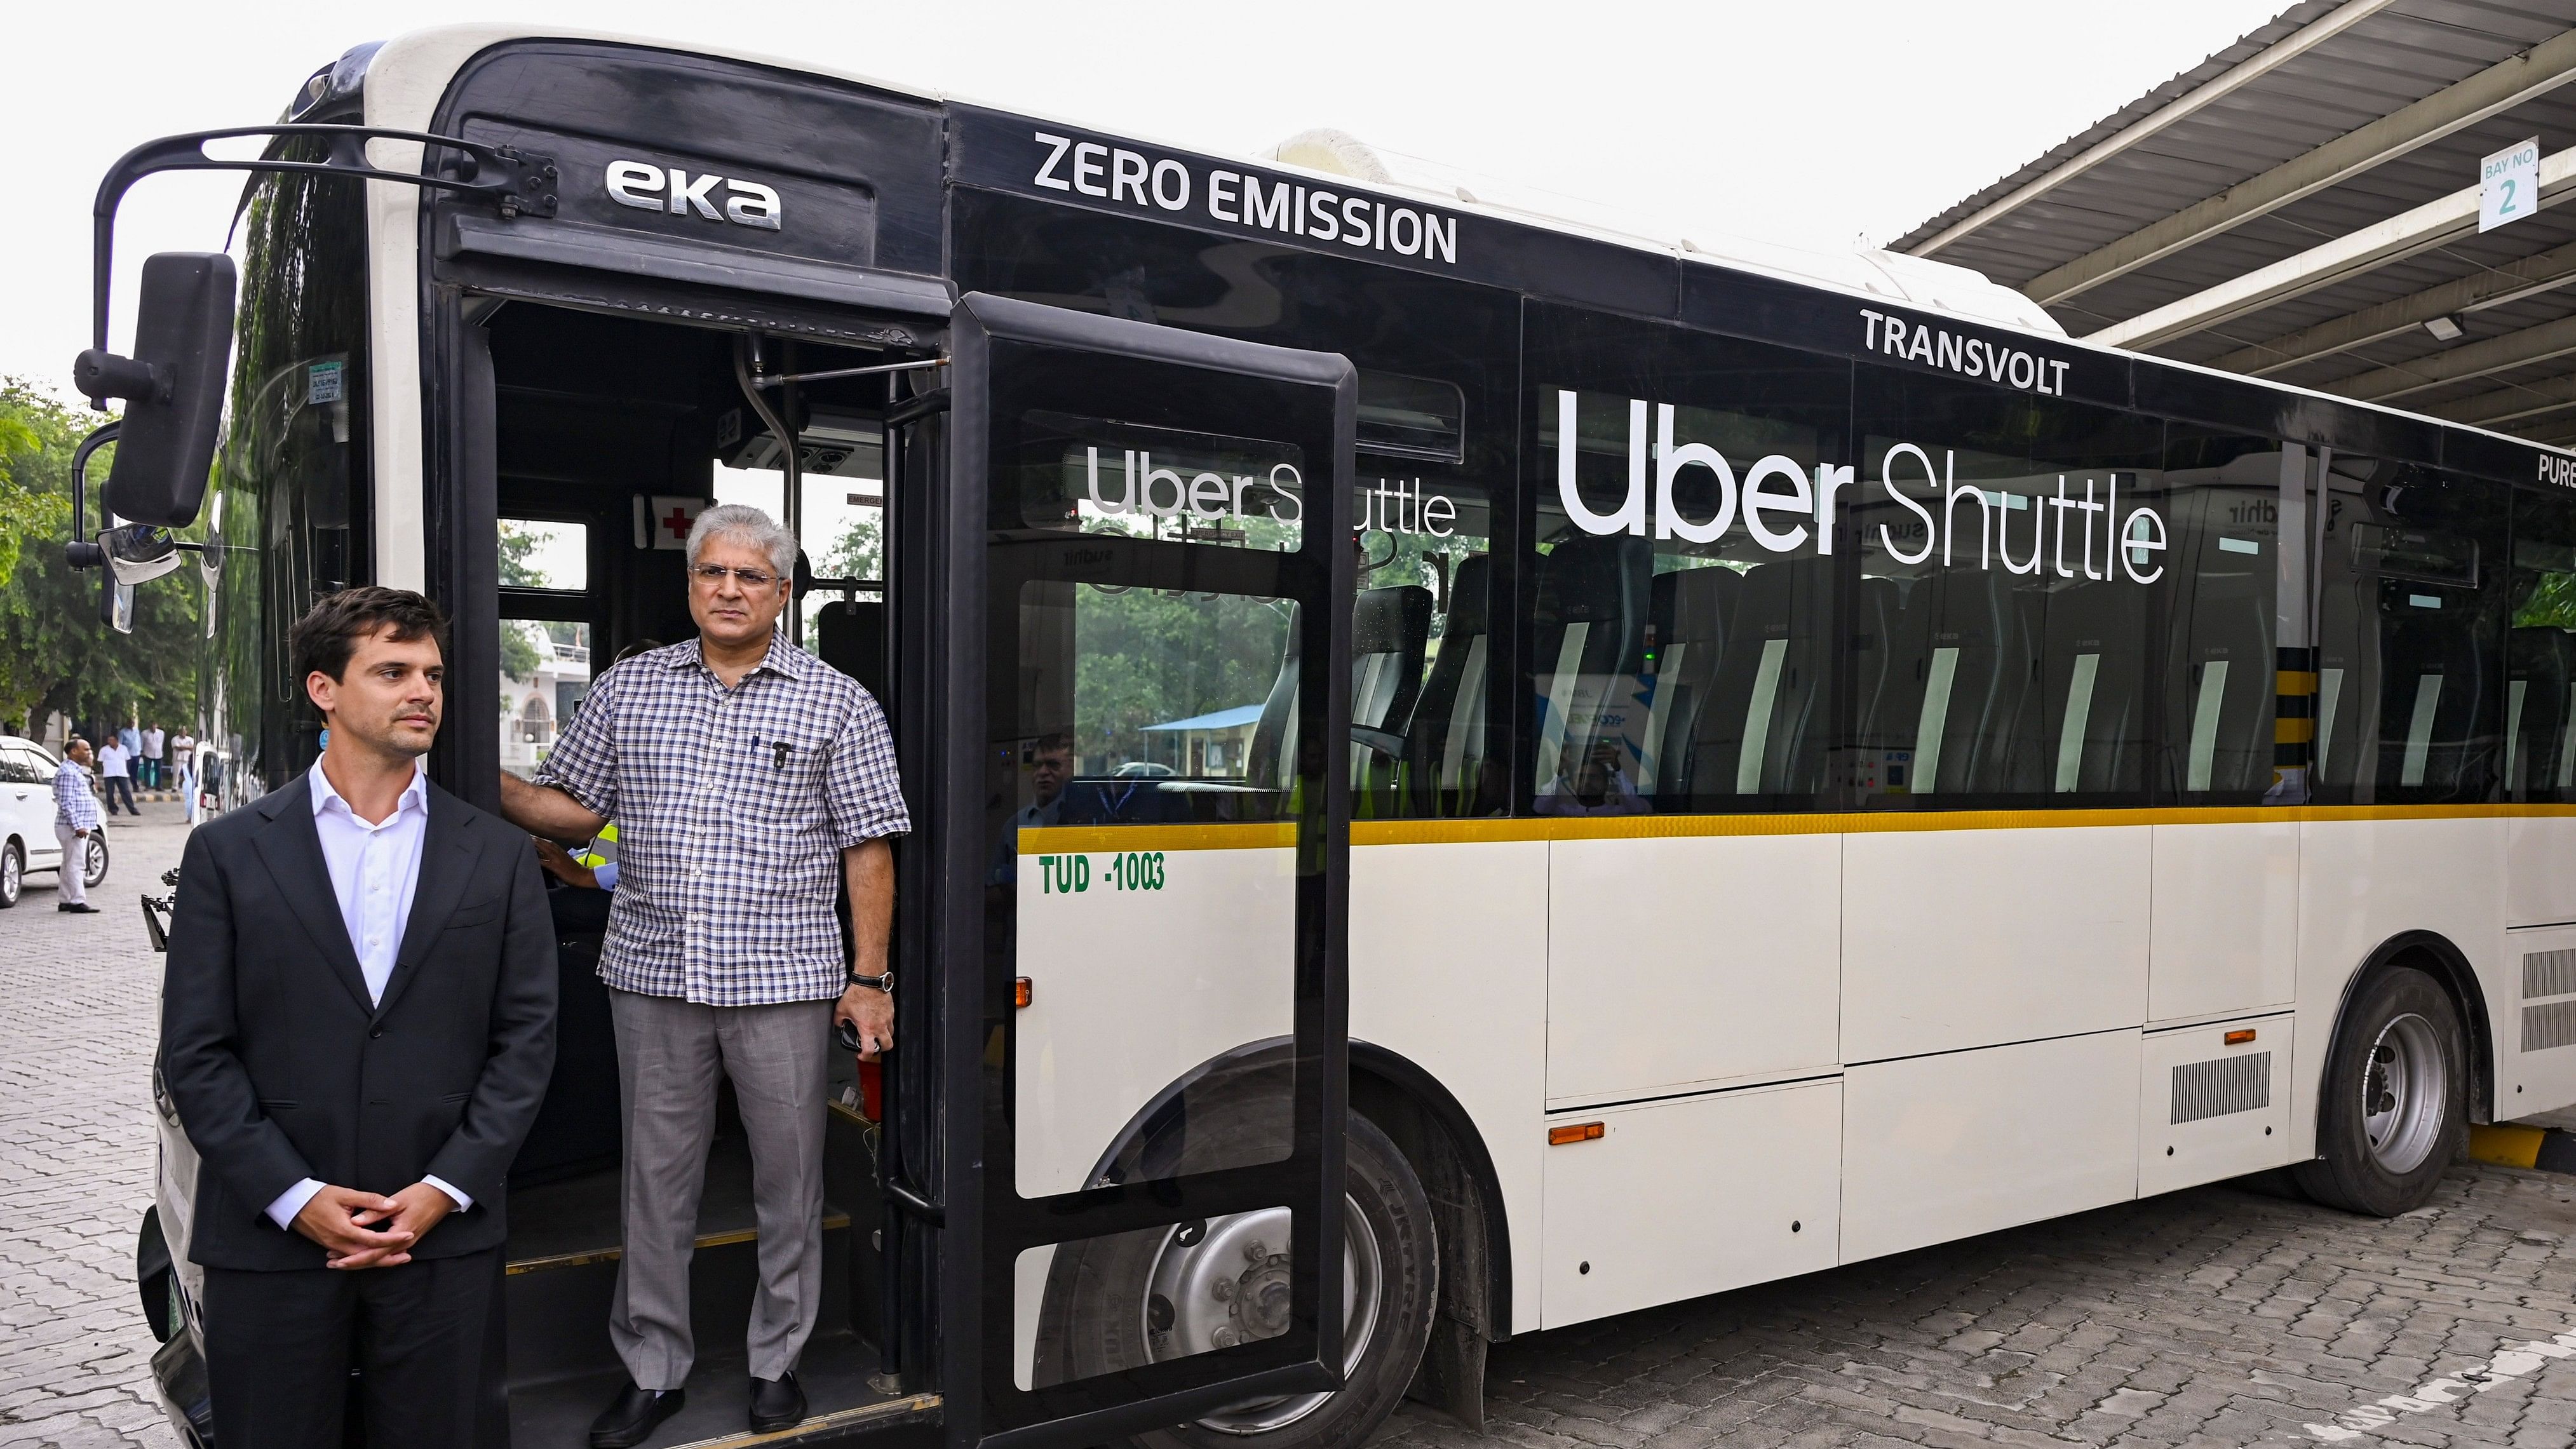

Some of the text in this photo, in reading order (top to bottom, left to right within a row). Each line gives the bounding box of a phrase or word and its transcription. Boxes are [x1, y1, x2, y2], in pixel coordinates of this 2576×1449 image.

[1034, 131, 1457, 264] ZERO EMISSION
[2485, 149, 2533, 179] BAY NO
[2499, 179, 2516, 215] 2
[1859, 309, 2070, 397] TRANSVOLT
[1088, 447, 1457, 538] Uber Suttle
[1558, 389, 2167, 584] Uber Shuttle
[1039, 851, 1165, 894] TUD -1003
